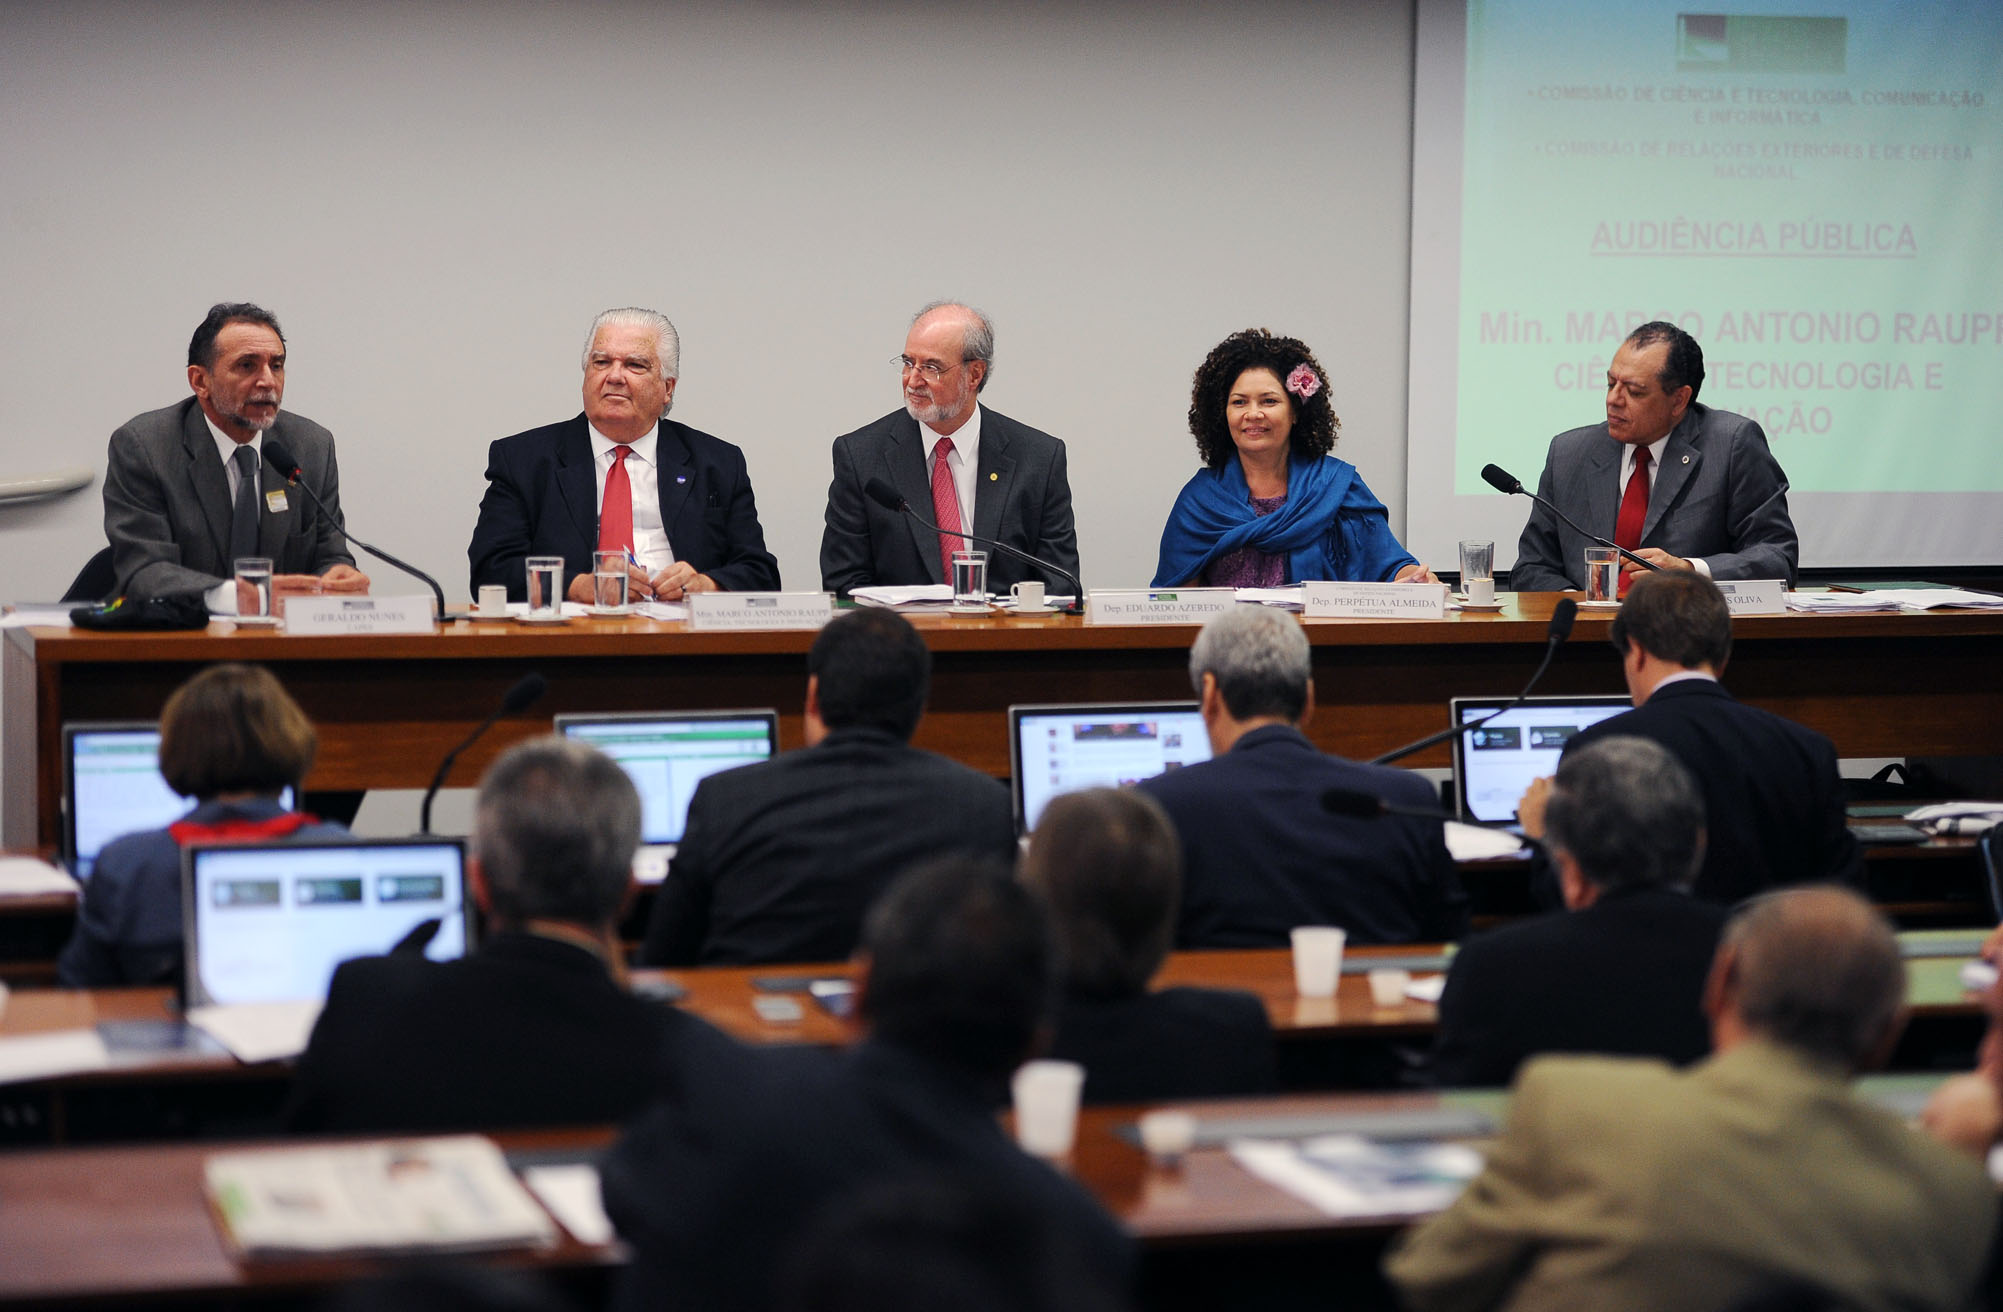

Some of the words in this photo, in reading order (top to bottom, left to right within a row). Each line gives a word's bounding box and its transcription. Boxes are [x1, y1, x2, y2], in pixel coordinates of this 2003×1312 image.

[1634, 86, 1655, 102] DE
[1731, 87, 1741, 103] E
[1694, 108, 1706, 124] E
[1640, 142, 1661, 158] DE
[1869, 144, 1878, 161] E
[1883, 144, 1905, 161] DE
[1910, 145, 1974, 162] DEFESA
[1591, 213, 1768, 251] AUDIÊNCIA
[1778, 215, 1918, 252] PÚBLICA
[1479, 310, 1553, 344] Min.
[1714, 310, 1881, 345] ANTONIO
[1707, 361, 1915, 391] TECNOLOGIA
[1924, 362, 1944, 390] E
[1334, 596, 1386, 607] PERPÉTUA
[1389, 599, 1437, 608] ALMEIDA
[1734, 595, 1763, 604] OLIVA
[1126, 604, 1175, 613] EDUARDO
[1179, 604, 1225, 613] AZEREDO
[369, 612, 405, 622] NUNES
[1141, 614, 1190, 622] PRESIDENTE
